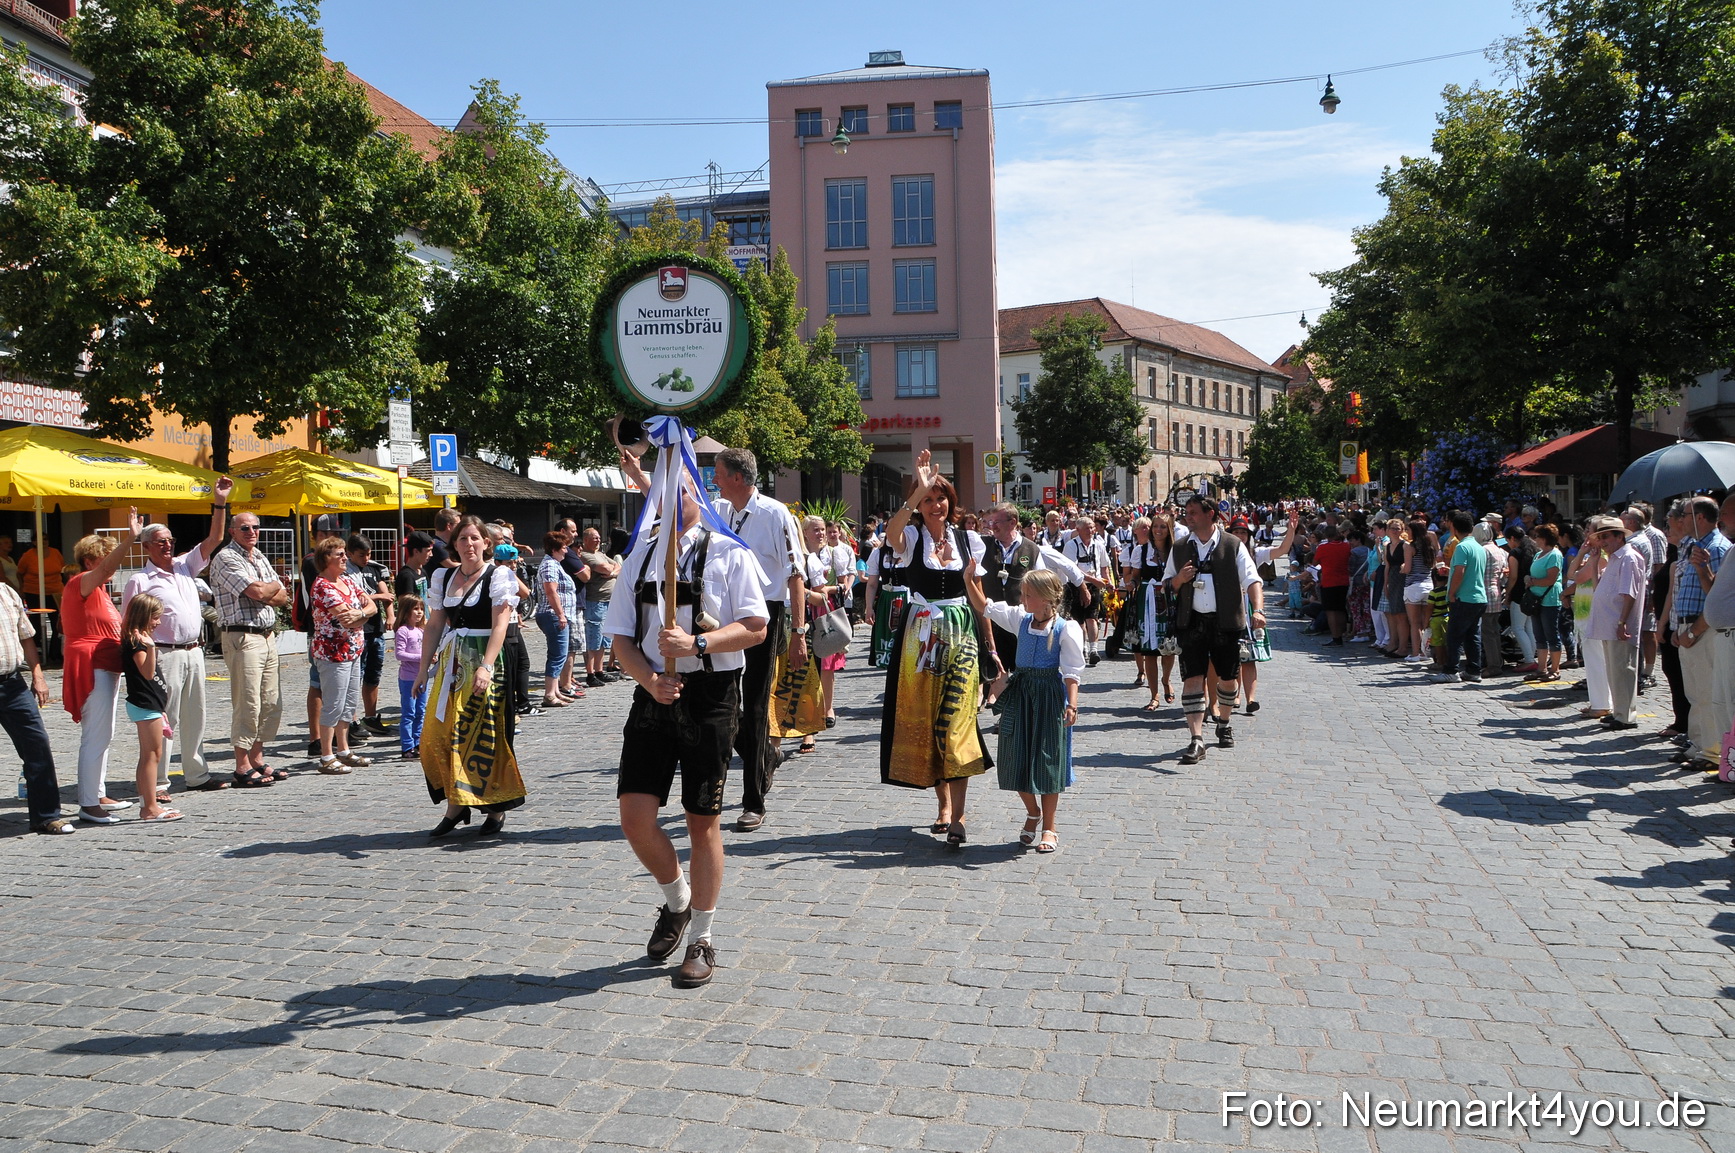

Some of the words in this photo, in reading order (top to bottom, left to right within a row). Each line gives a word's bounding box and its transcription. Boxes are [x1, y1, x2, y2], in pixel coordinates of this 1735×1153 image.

[638, 306, 710, 318] Neumarkter
[624, 319, 722, 336] Lammsbräu
[230, 433, 260, 453] Heiße
[435, 438, 451, 467] P
[69, 479, 106, 490] Bäckerei
[116, 480, 134, 490] Café
[145, 481, 185, 492] Konditorei
[339, 490, 362, 499] Bäckerei
[368, 489, 380, 499] Café
[386, 490, 413, 500] Kondorei
